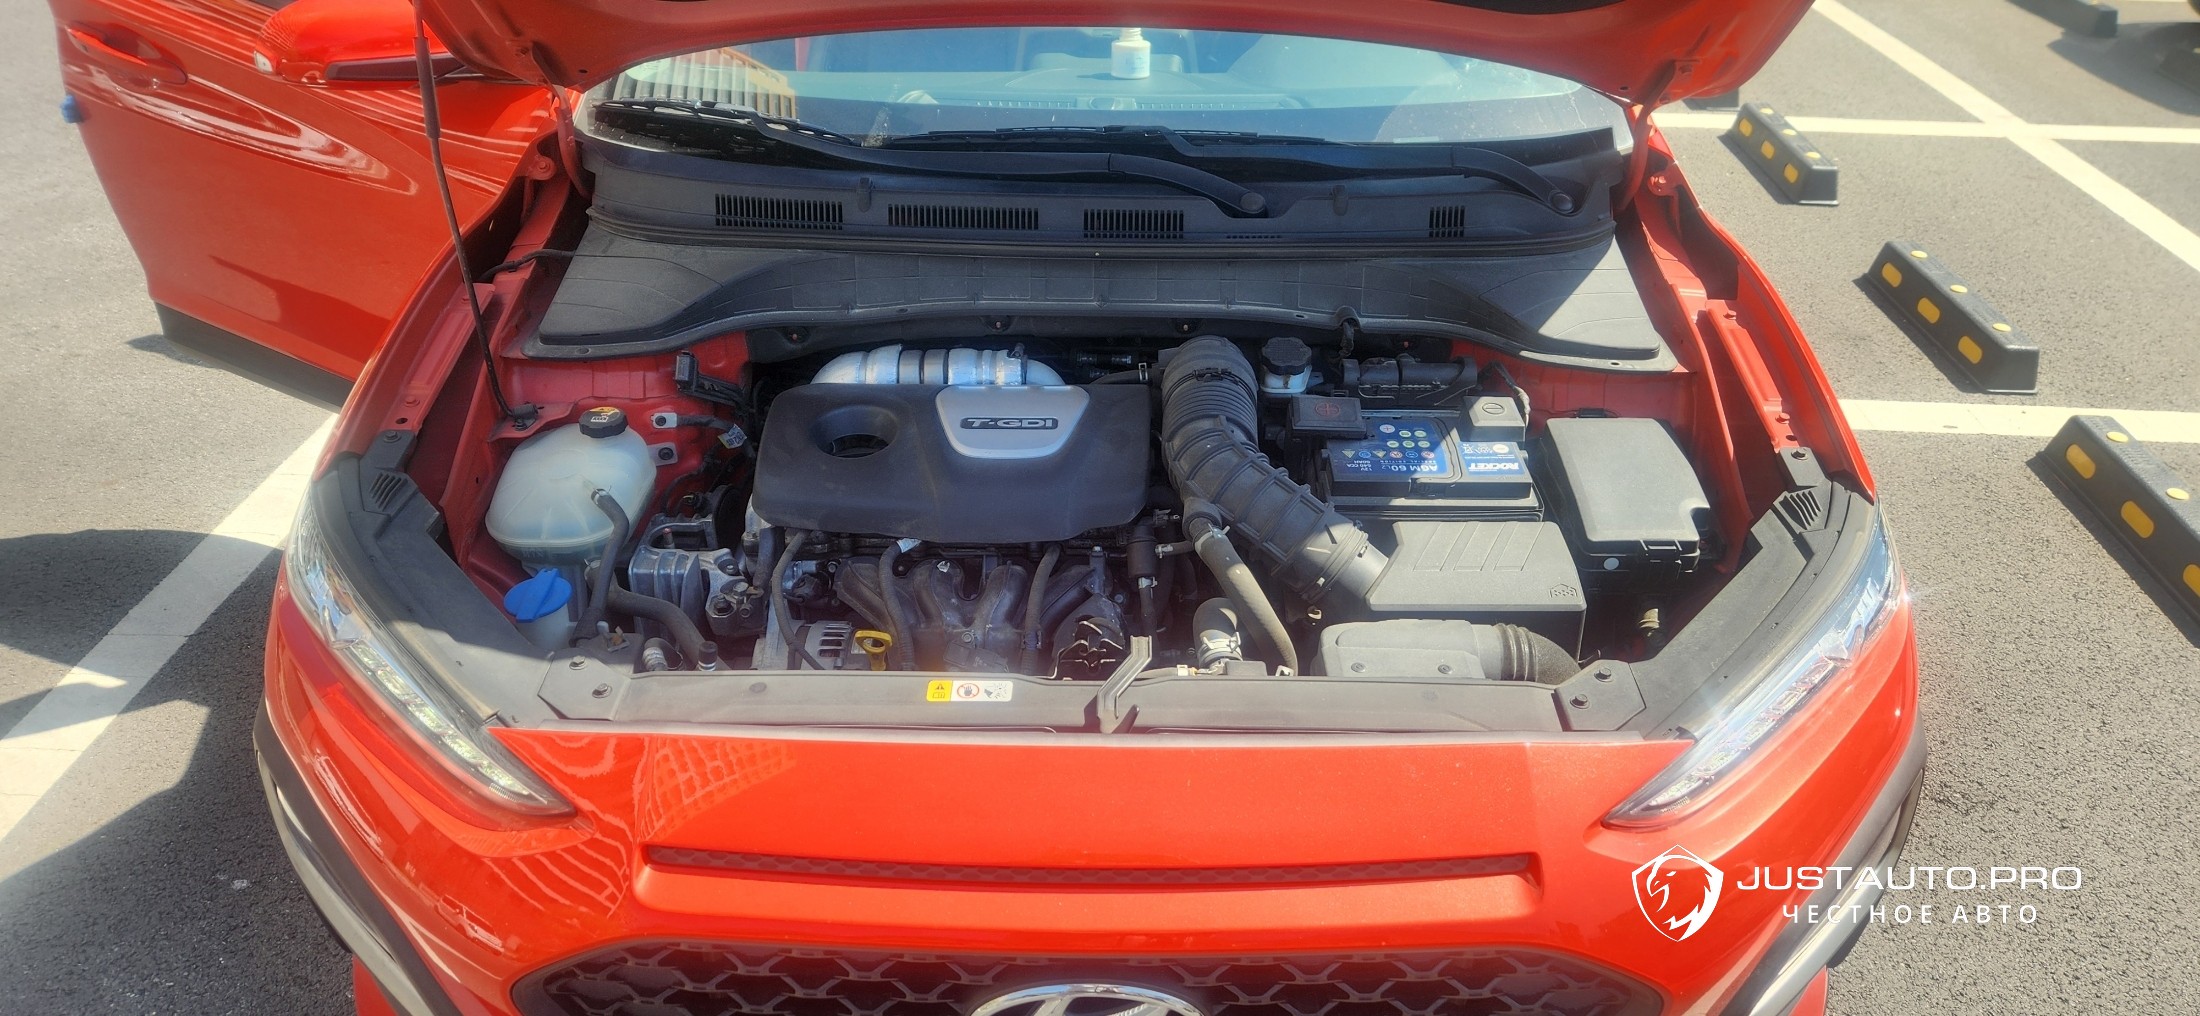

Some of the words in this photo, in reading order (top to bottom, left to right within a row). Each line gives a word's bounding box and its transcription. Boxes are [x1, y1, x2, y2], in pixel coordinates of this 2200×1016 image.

[967, 418, 1052, 427] T-GDI
[1409, 464, 1438, 472] AGM
[1468, 462, 1519, 470] ROCKET
